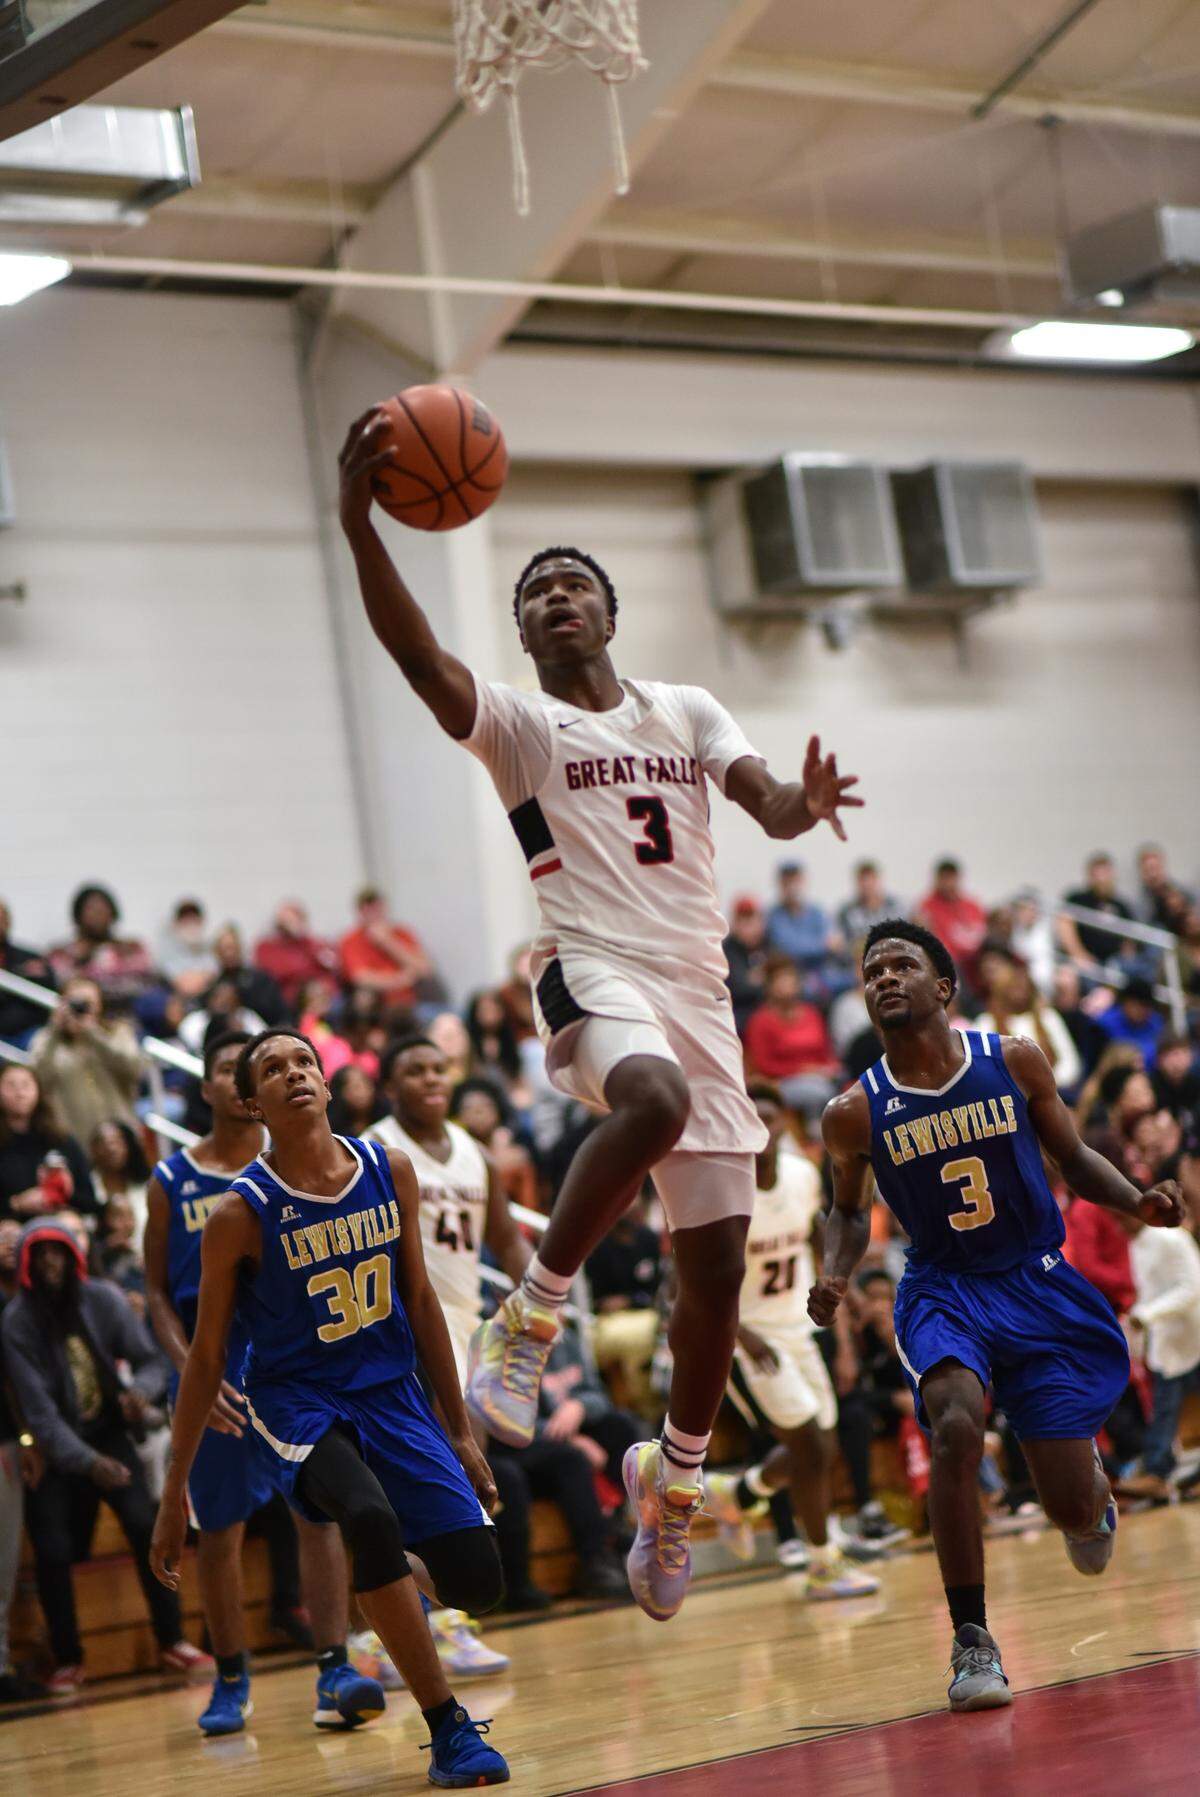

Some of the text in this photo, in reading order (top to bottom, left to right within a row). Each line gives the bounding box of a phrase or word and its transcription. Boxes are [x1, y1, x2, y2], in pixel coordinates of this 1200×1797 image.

[565, 756, 635, 790] GREAT
[626, 795, 674, 865] 3
[883, 1095, 1017, 1166] LEWISVILLE
[940, 1156, 995, 1232] 3
[280, 1200, 400, 1270] LEWISVILLE
[307, 1253, 392, 1343] 30
[761, 1255, 796, 1297] 21
